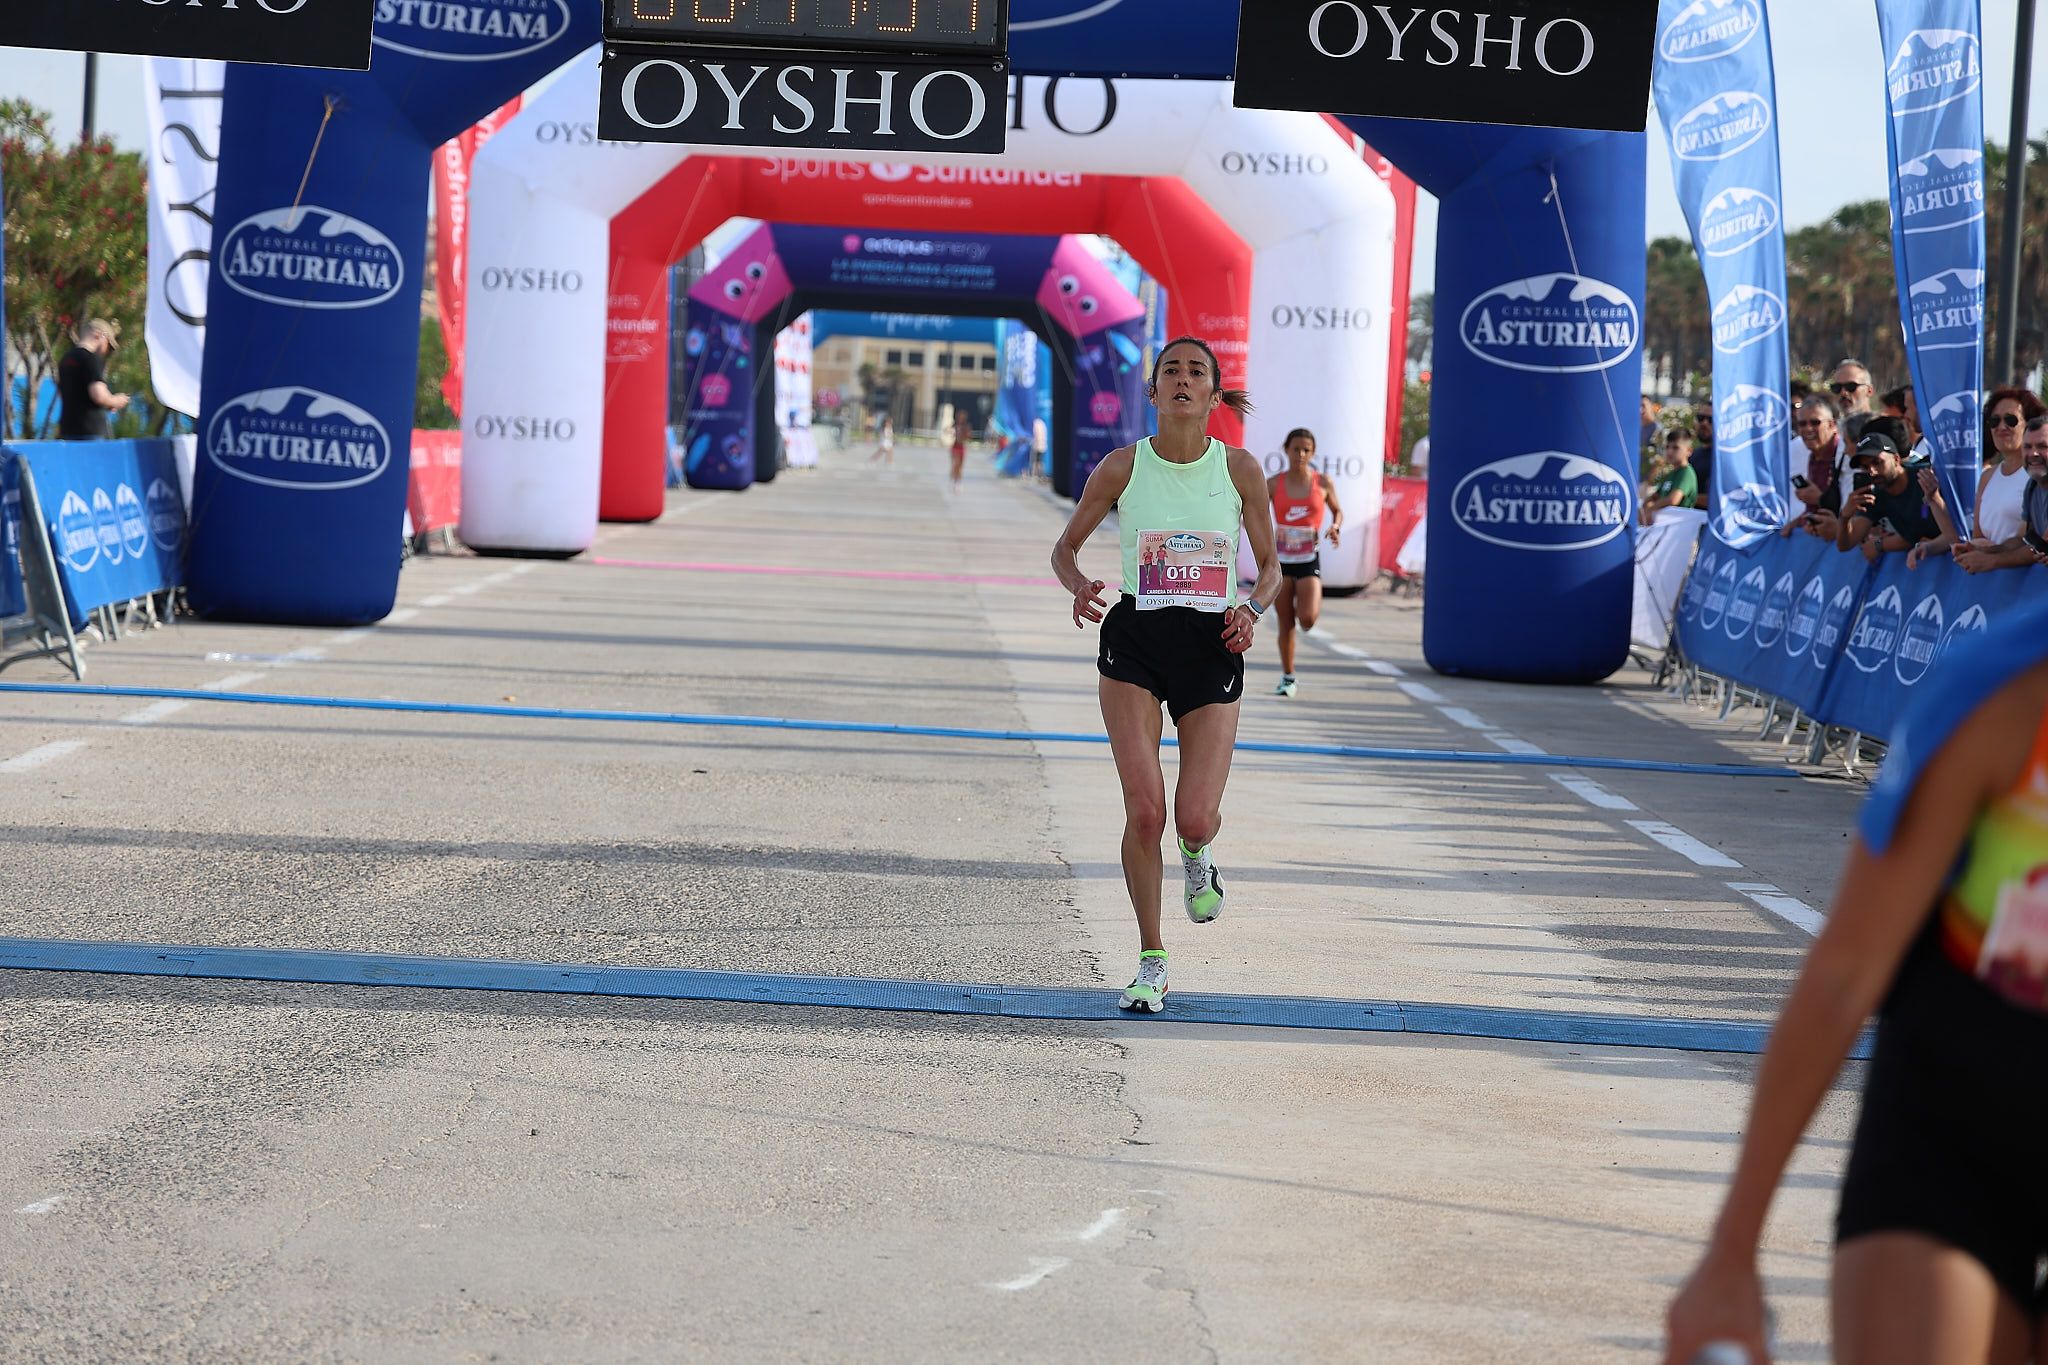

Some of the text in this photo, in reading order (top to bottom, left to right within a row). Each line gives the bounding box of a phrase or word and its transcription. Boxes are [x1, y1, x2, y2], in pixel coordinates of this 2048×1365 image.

[374, 0, 549, 39] STURIANA
[1308, 0, 1594, 76] OYSHO
[620, 59, 987, 140] OYSHO
[1221, 151, 1328, 176] OYSHO
[228, 237, 392, 290] ASTURIANA
[481, 267, 583, 294] OYSHO
[1271, 304, 1372, 331] OYSHO
[1501, 305, 1568, 317] CENTRAL
[1472, 307, 1631, 347] ASTURIANA
[474, 414, 576, 442] OYSHO
[216, 418, 378, 470] ASTURIANA
[1463, 484, 1623, 525] ASTURIANA
[1168, 540, 1202, 549] ASTURIANA
[1166, 566, 1201, 580] 016
[1146, 598, 1218, 608] OYSHO Santander
